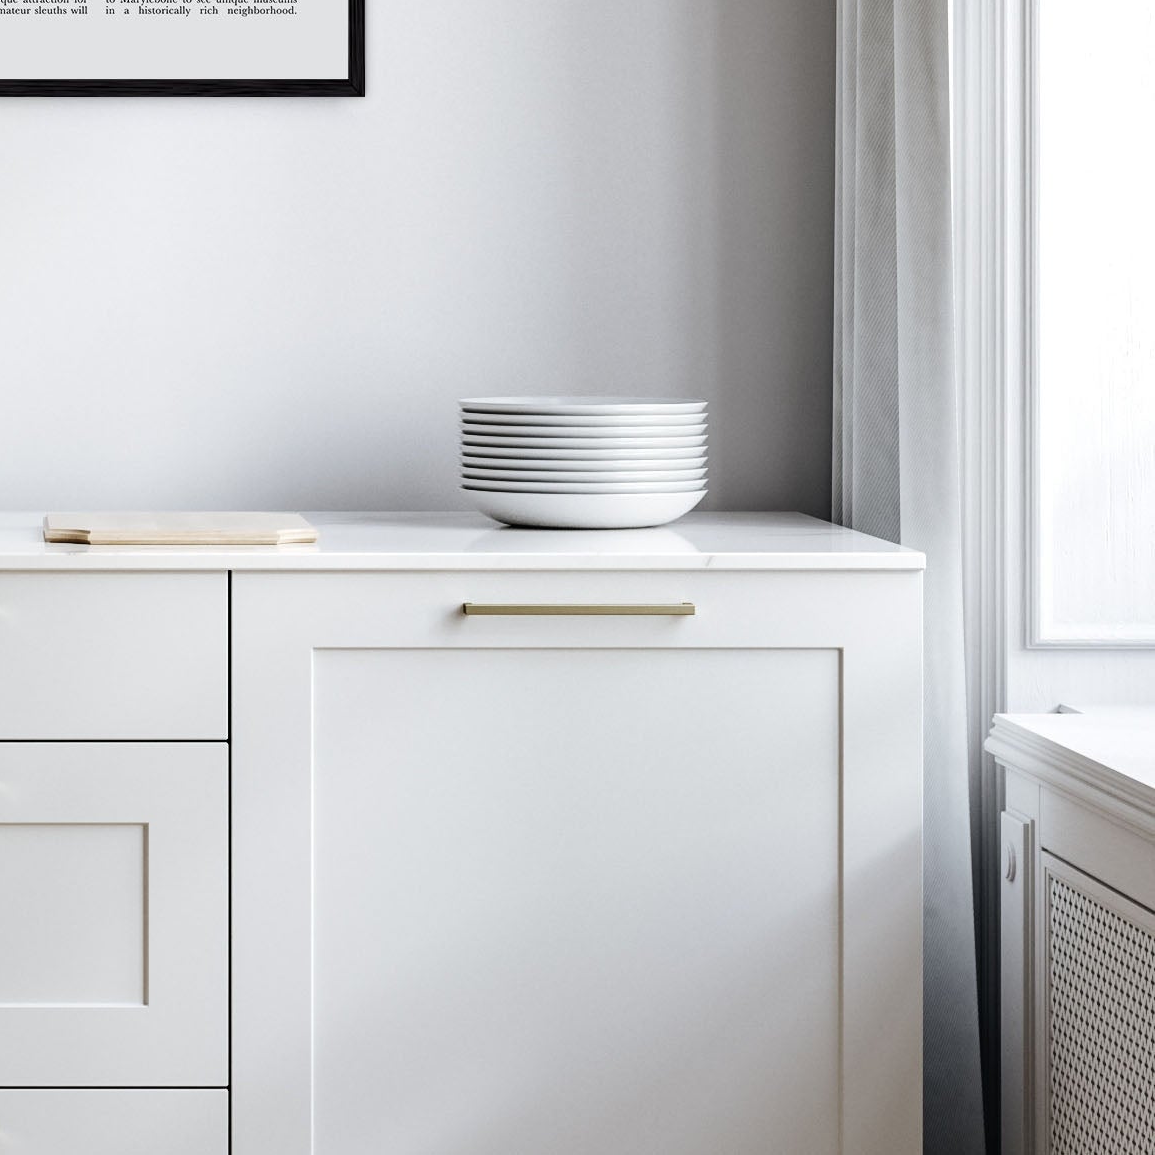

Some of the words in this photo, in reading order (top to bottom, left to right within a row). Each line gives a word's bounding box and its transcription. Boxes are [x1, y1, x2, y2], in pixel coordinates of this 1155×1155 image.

[35, 6, 67, 15] sleuths
[71, 6, 87, 15] will
[106, 6, 115, 15] in
[139, 6, 191, 17] historically
[200, 6, 218, 15] rich
[228, 6, 297, 17] neighborhood.
